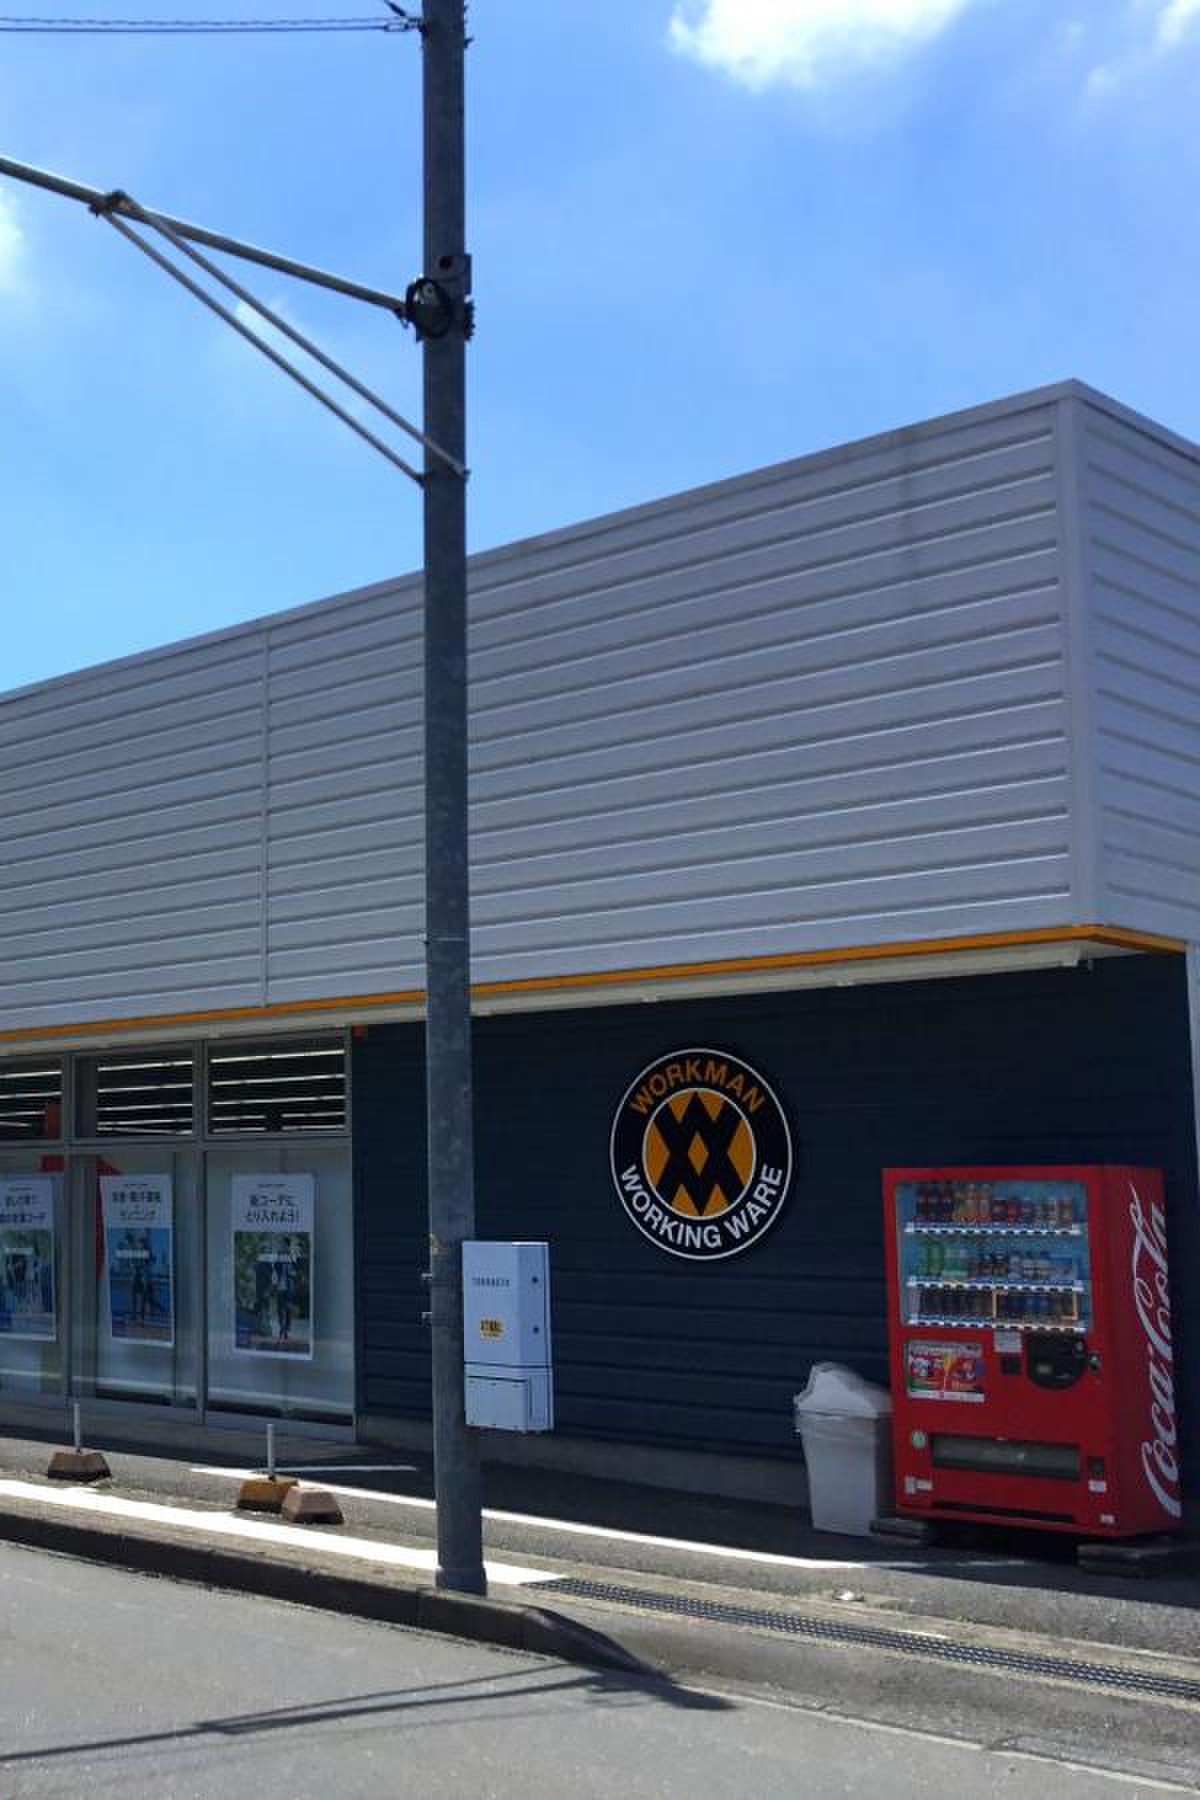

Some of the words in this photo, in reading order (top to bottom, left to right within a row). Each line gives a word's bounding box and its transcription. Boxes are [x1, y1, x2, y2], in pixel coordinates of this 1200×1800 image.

[629, 1059, 767, 1115] WORKMAN
[620, 1164, 723, 1249] WORKING
[723, 1163, 784, 1240] WARE
[1128, 1182, 1183, 1518] Coca-Cola
